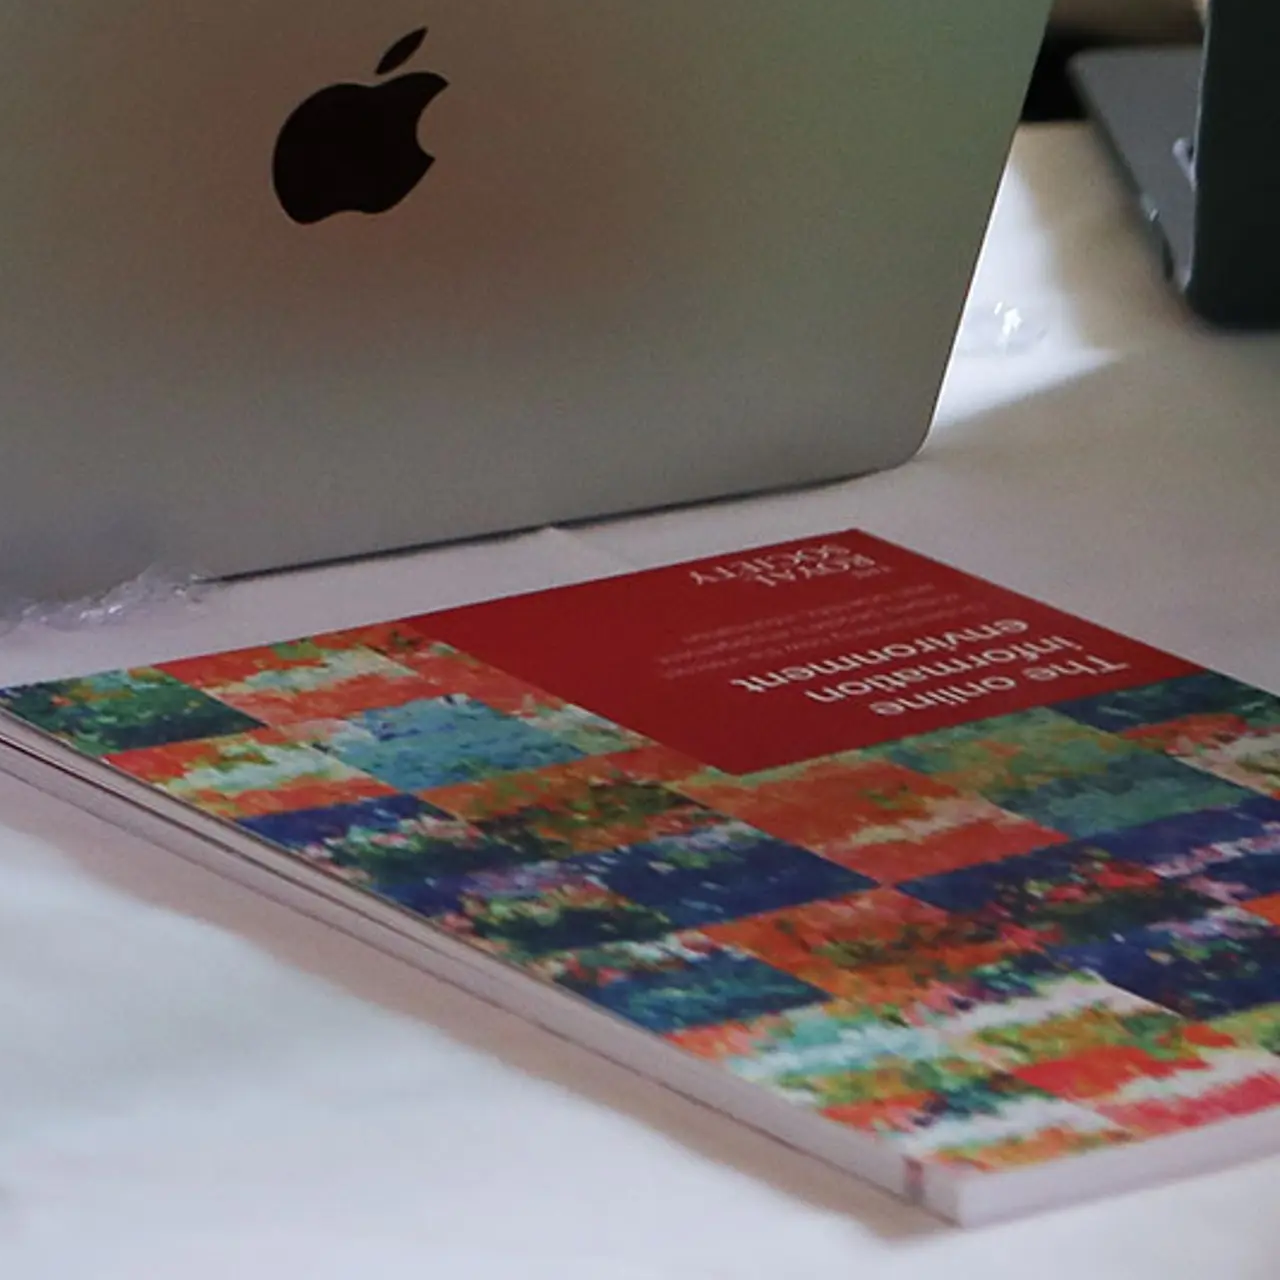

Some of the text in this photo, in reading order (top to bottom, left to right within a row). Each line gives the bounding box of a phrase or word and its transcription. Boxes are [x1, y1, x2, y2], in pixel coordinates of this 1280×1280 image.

[729, 618, 1030, 693] environment
[804, 635, 1084, 704] information
[868, 654, 1131, 717] The online
